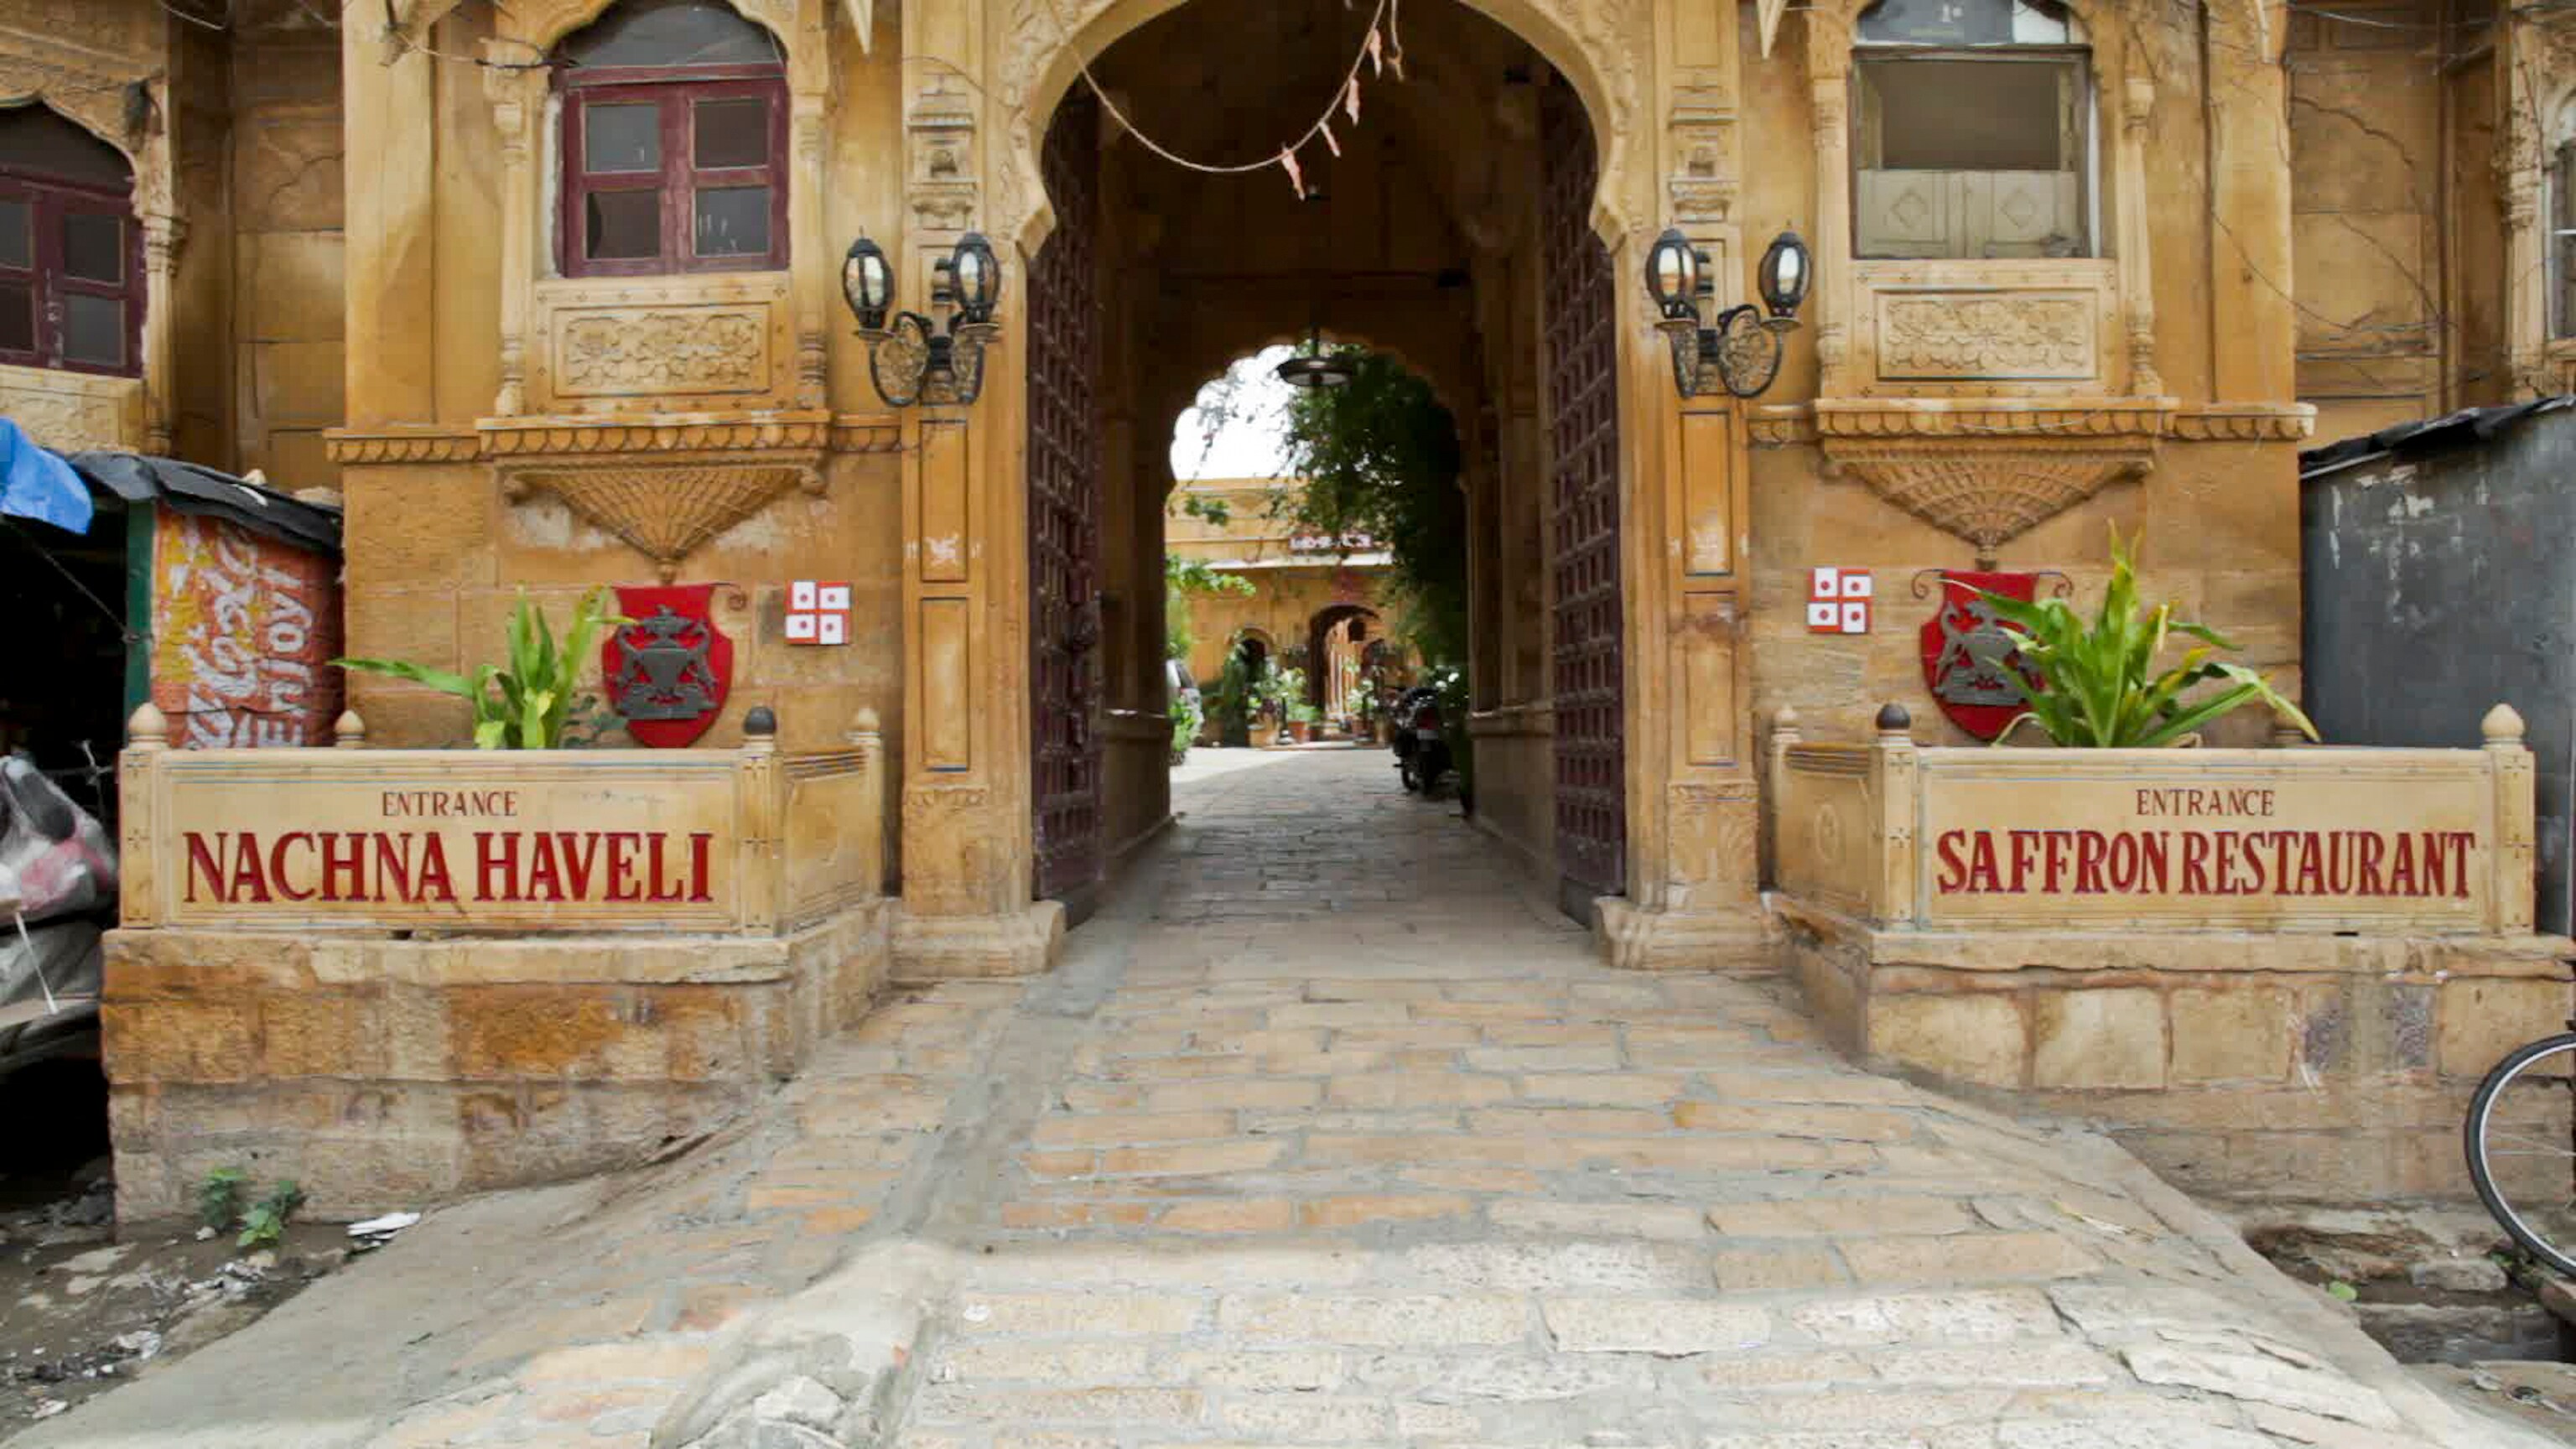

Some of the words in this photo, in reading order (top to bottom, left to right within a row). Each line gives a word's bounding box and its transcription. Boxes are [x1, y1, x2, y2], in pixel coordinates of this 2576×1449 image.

[382, 791, 517, 817] ENTRANCE
[2137, 788, 2274, 816] ENTRANCE
[182, 831, 457, 902] NACHNA
[472, 831, 714, 902] HAVELI
[1936, 828, 2171, 895] SAFFRON
[2179, 830, 2475, 898] RESTAURANT
